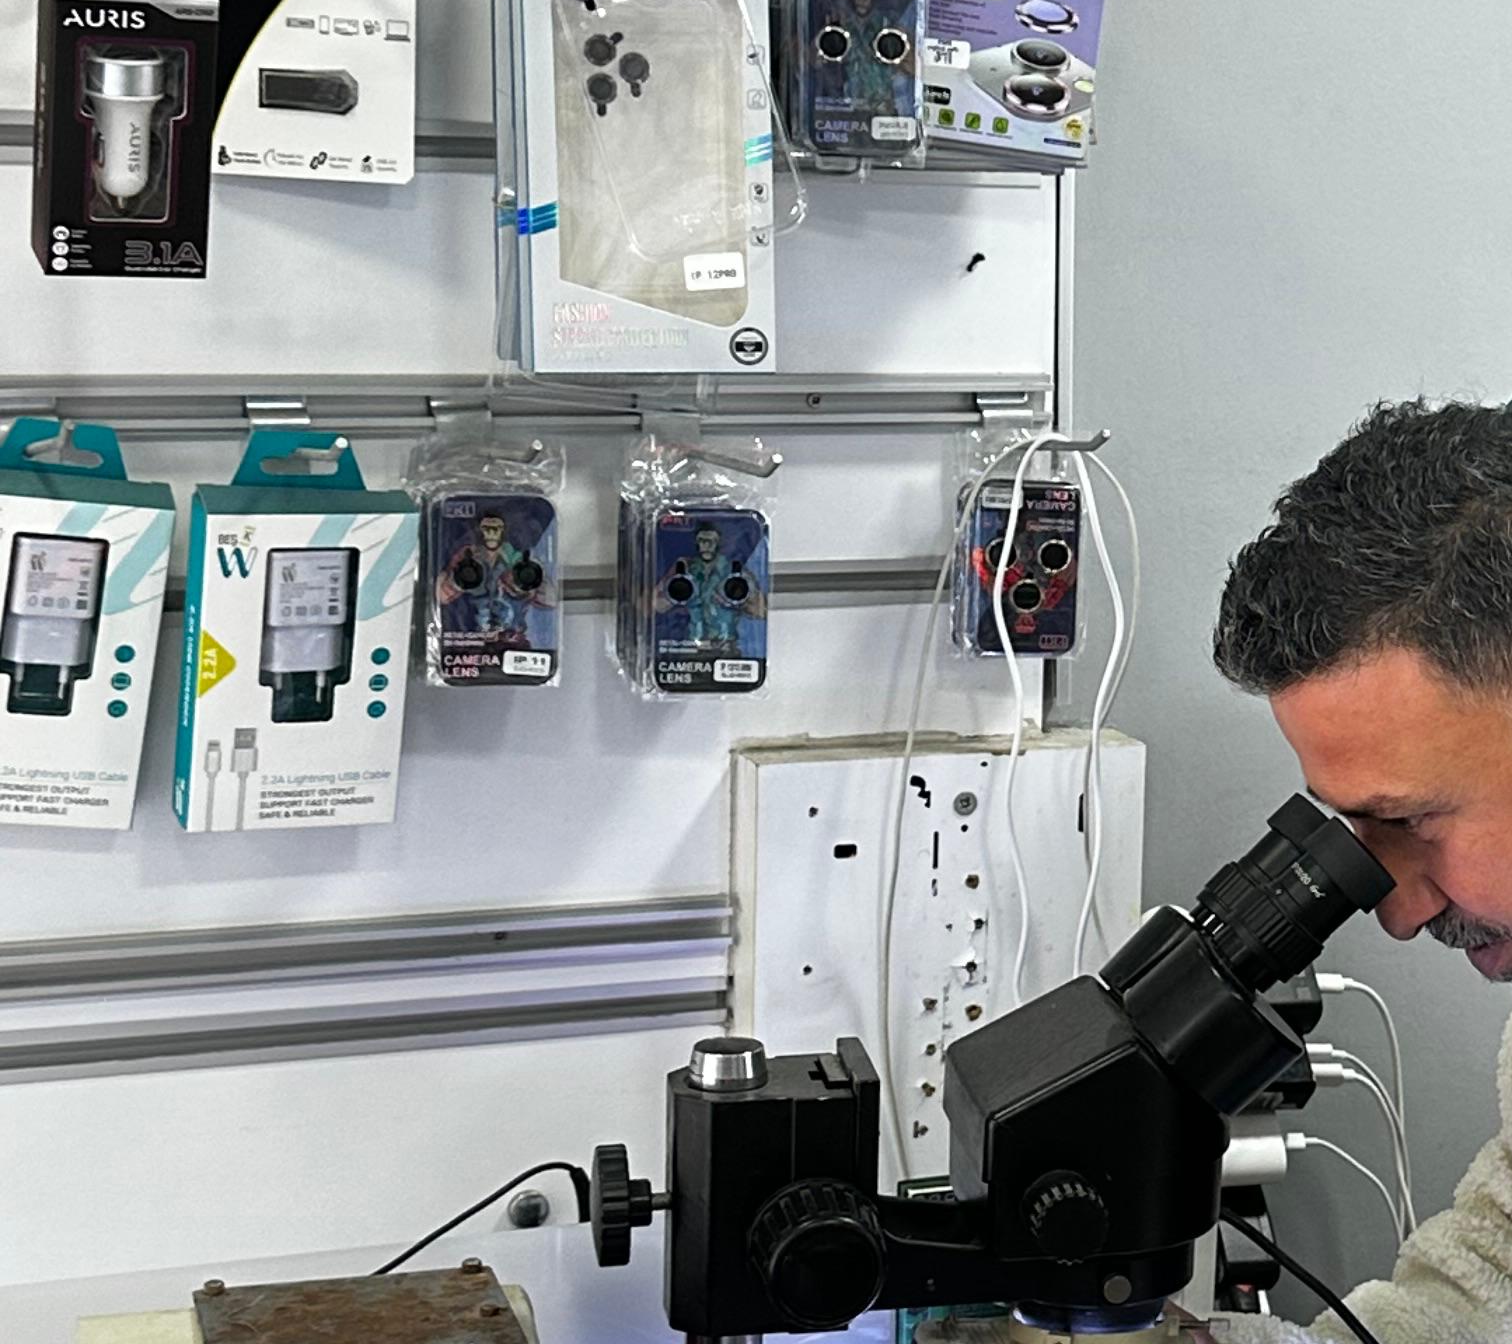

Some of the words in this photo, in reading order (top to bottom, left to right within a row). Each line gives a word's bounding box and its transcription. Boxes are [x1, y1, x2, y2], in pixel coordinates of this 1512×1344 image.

[63, 8, 146, 30] AURIS
[815, 120, 869, 132] CAMERA
[816, 131, 849, 143] LENS
[128, 122, 141, 173] AURIS
[124, 240, 204, 266] 3.1A
[1045, 490, 1077, 501] LENS
[1026, 500, 1077, 512] CAMERA
[202, 648, 217, 680] 2.2A
[444, 655, 501, 666] CAMERA
[444, 667, 479, 678] LENS
[658, 661, 713, 673] CAMERA
[659, 673, 692, 684] LENS
[19, 768, 69, 782] Lightning
[72, 770, 96, 780] USB
[98, 771, 128, 781] Cable
[287, 773, 336, 787] Lightning
[337, 771, 361, 781] USB
[362, 770, 391, 780] Cable
[50, 785, 91, 794] OUTPUT
[318, 786, 356, 796] OUTPUT
[36, 796, 62, 804] FAST
[63, 796, 109, 807] CHARGER
[260, 799, 303, 810] SUPPORT
[304, 798, 329, 807] FAST
[330, 795, 374, 805] CHARGER
[22, 805, 68, 816] RELIABLE
[259, 810, 282, 820] SAFE
[292, 808, 335, 818] RELIABLE
